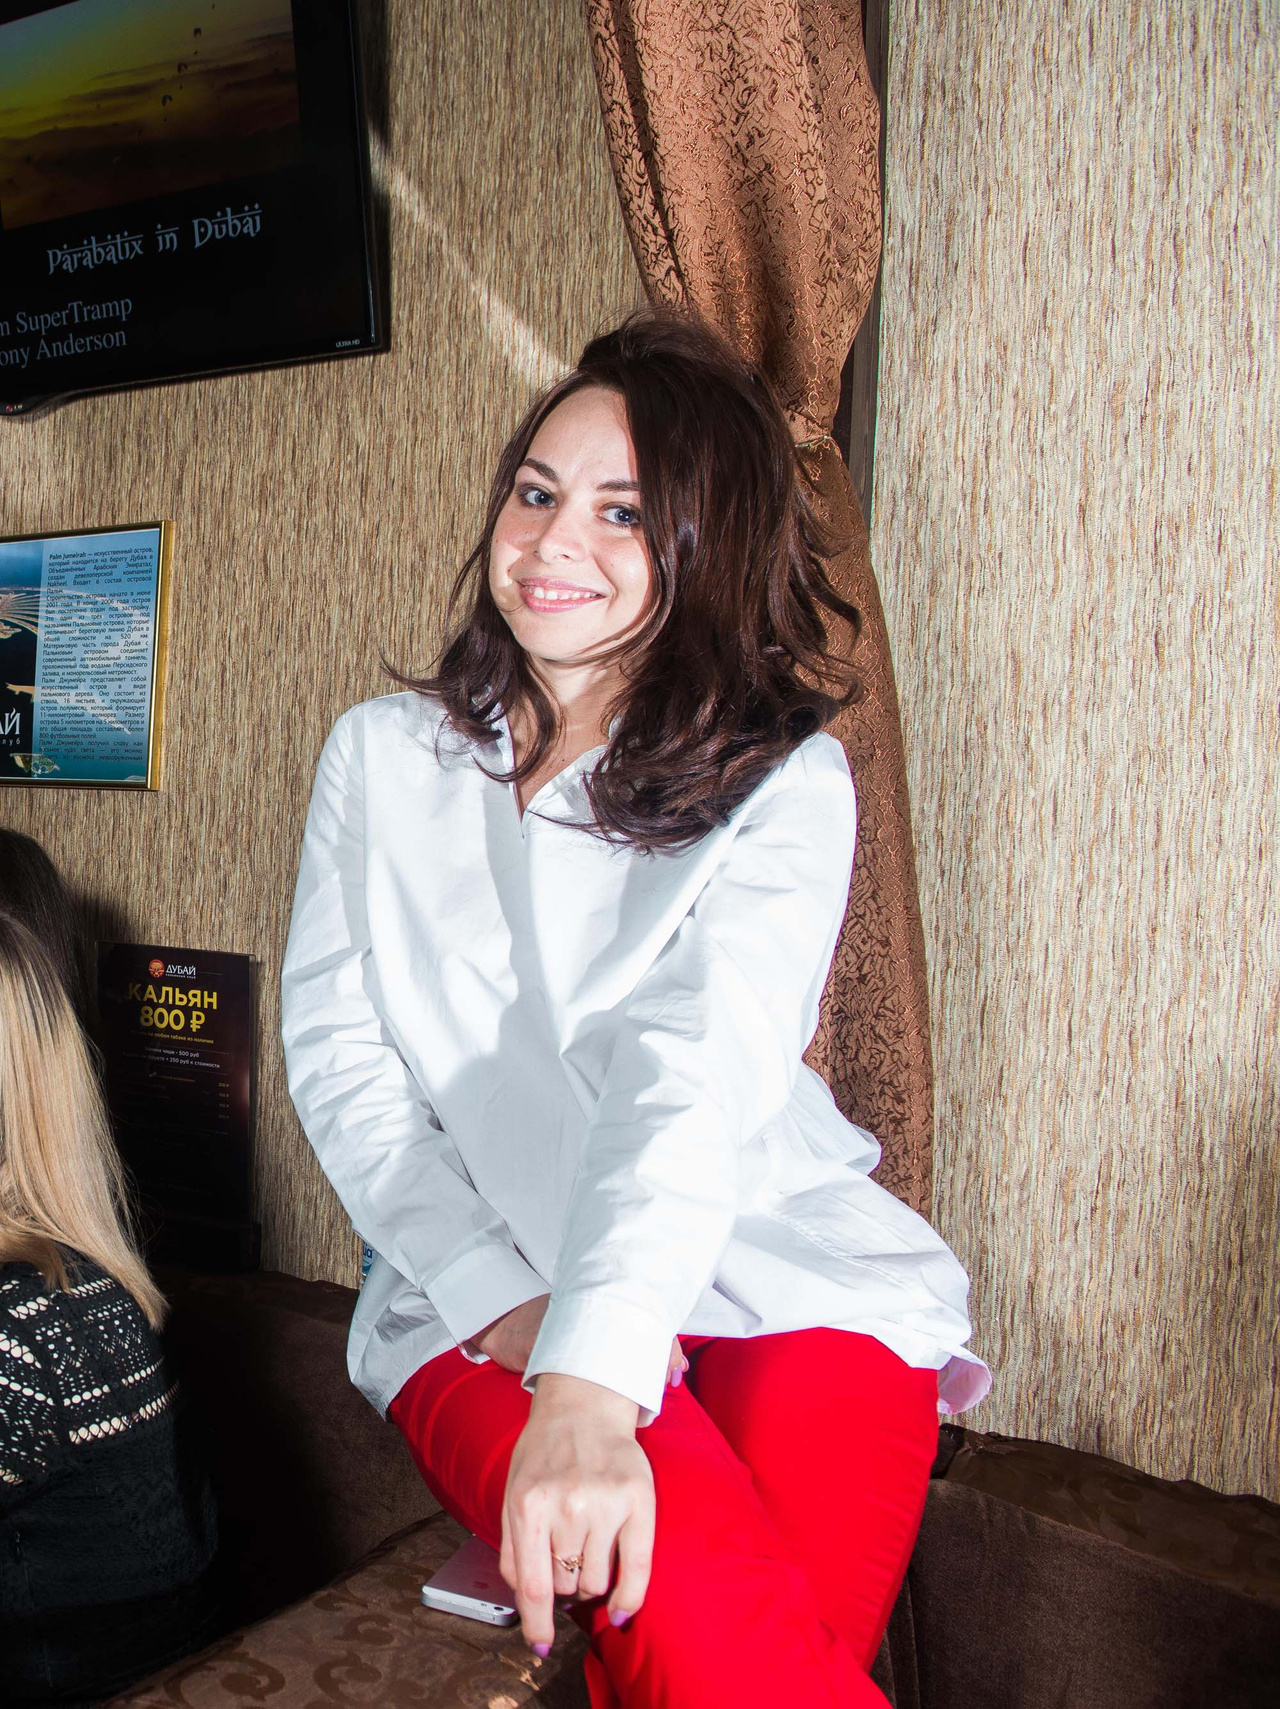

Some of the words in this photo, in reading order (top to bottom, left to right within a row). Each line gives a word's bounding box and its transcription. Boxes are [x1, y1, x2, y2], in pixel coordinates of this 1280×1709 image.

[155, 224, 179, 252] in
[192, 203, 263, 248] Dubai
[16, 298, 133, 335] SuperTramp
[36, 330, 127, 360] Anderson
[166, 964, 196, 976] ДУБАЙ
[128, 982, 217, 1010] КАЛЬЯН
[140, 1006, 185, 1031] 800
